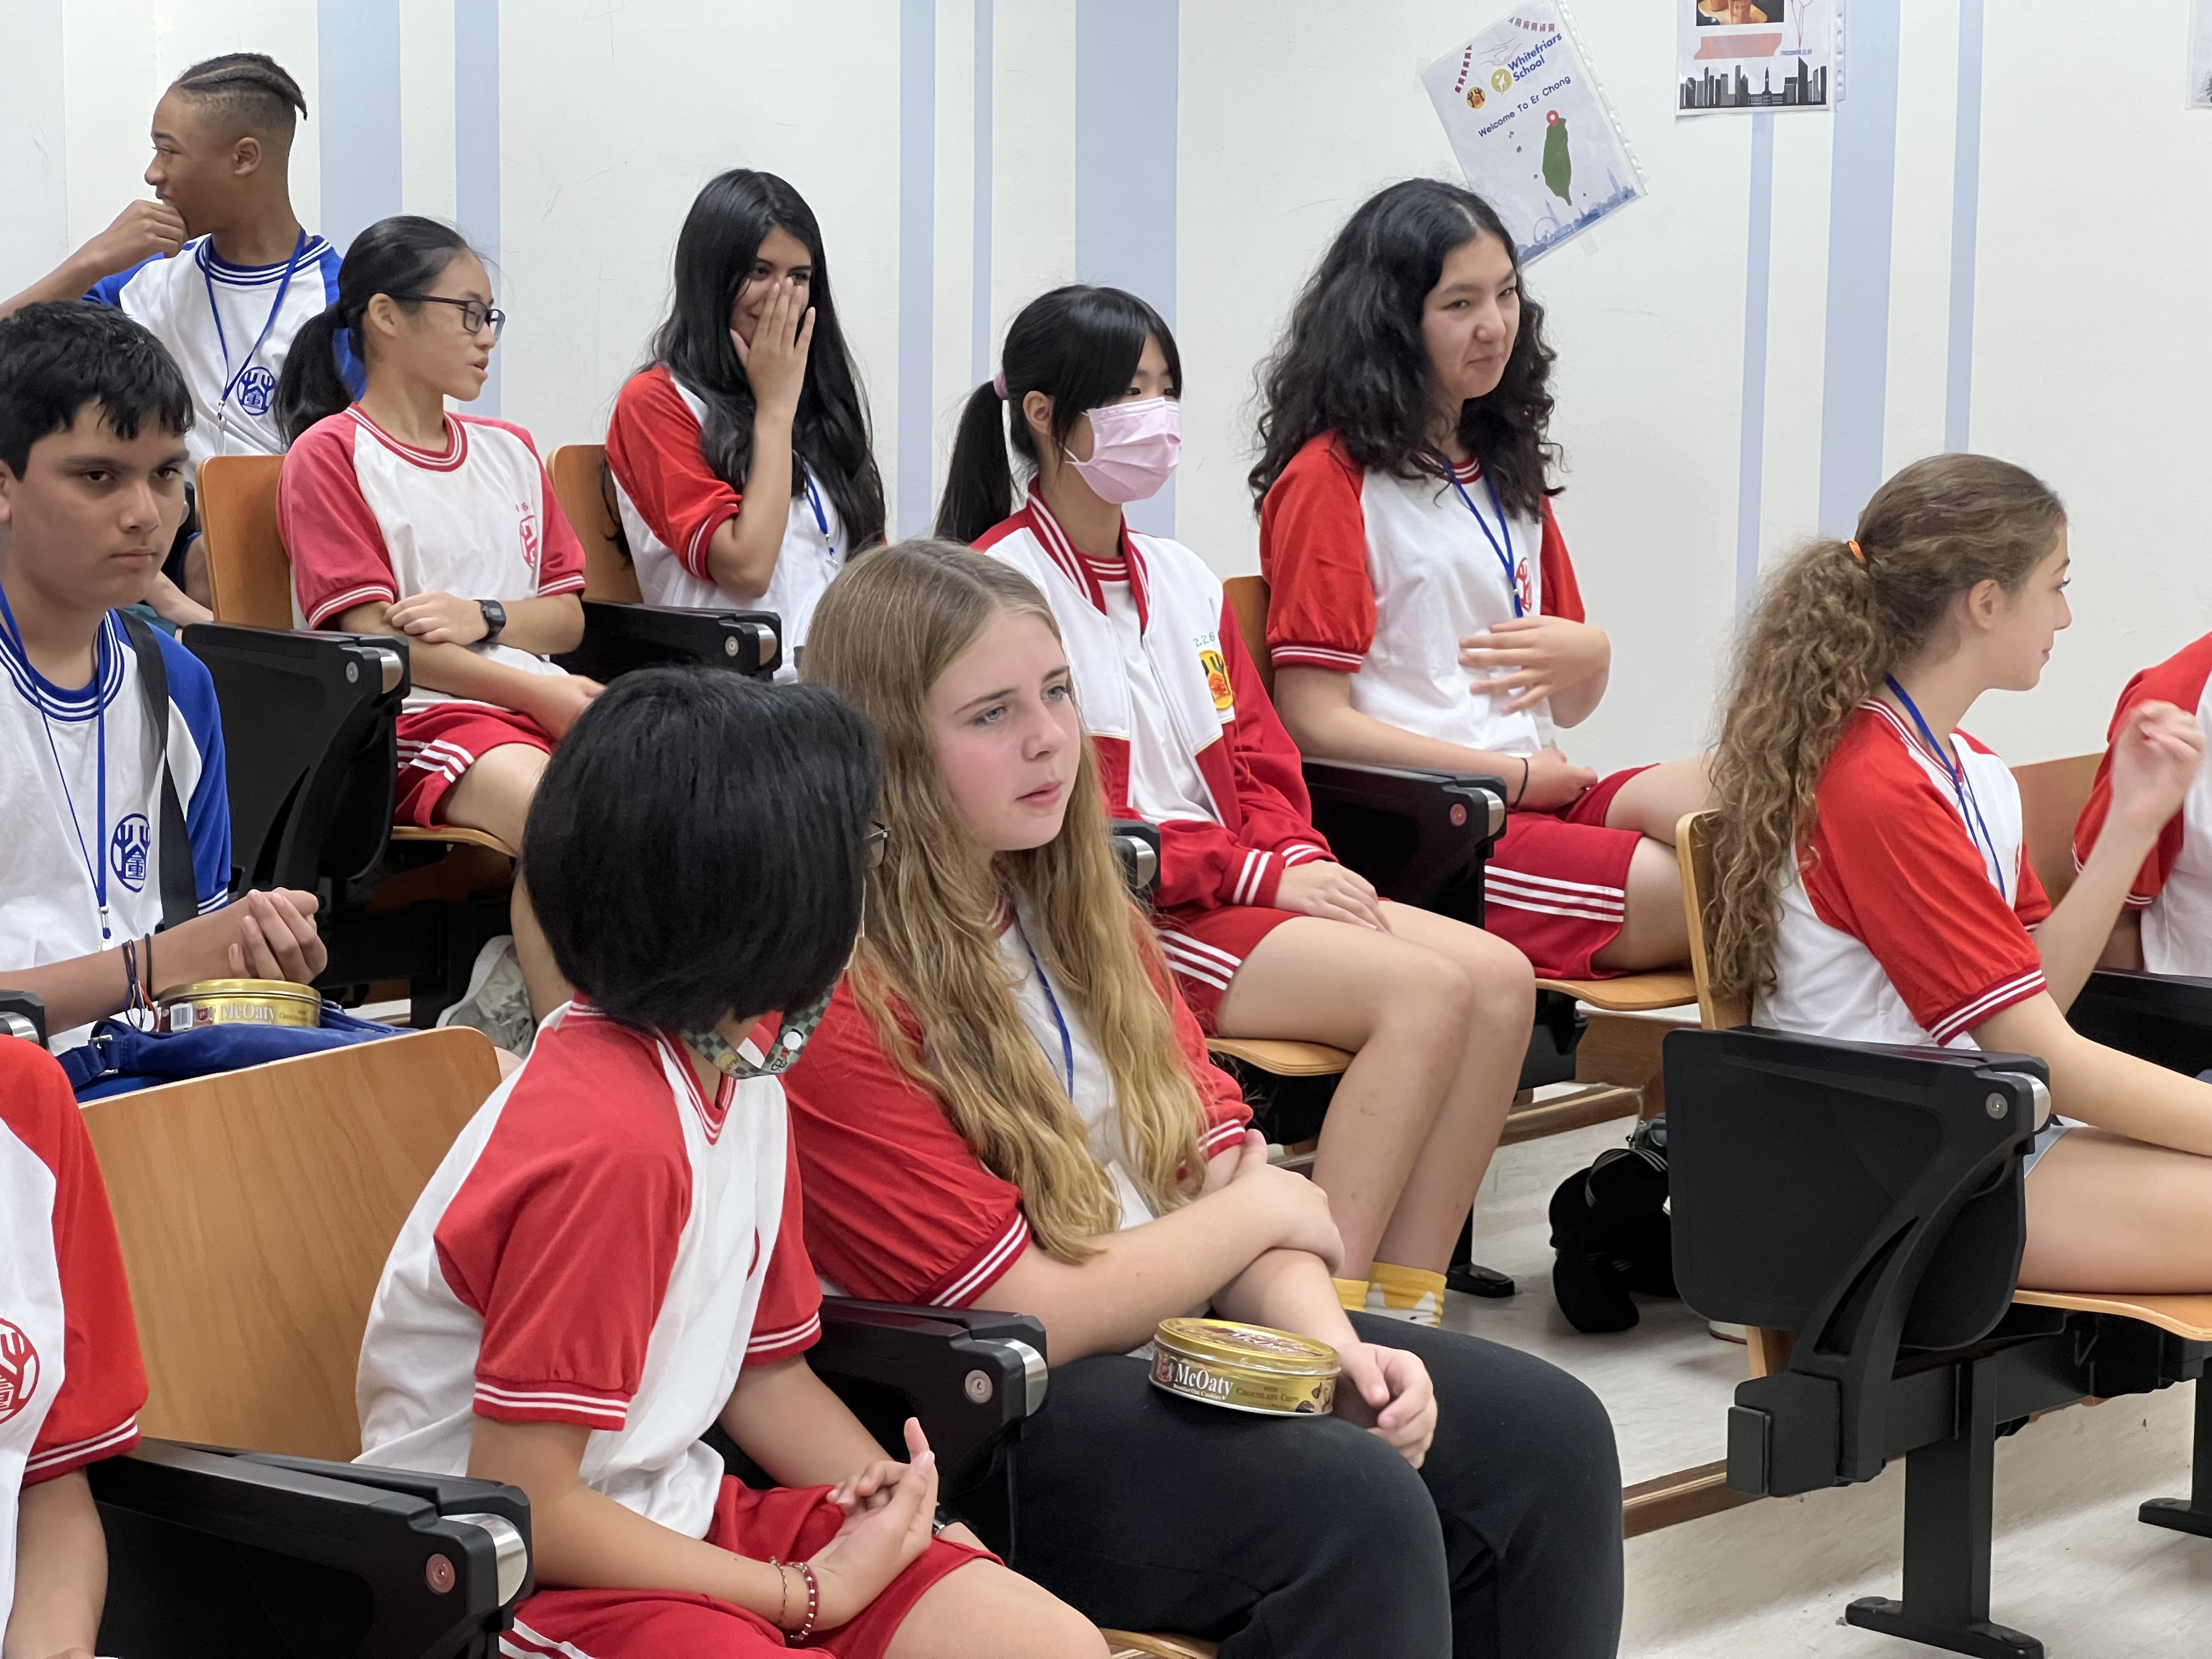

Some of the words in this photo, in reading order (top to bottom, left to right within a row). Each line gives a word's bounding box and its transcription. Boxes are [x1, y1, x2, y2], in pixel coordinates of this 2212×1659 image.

[1508, 33, 1562, 71] Whitefriars
[1513, 54, 1545, 81] School
[1478, 111, 1515, 137] Welcome
[1517, 103, 1528, 112] To
[1530, 94, 1539, 104] Er
[1542, 76, 1571, 96] Chong
[1193, 631, 1215, 647] 226
[220, 1003, 276, 1025] McOaty
[1175, 1363, 1234, 1400] McOaty
